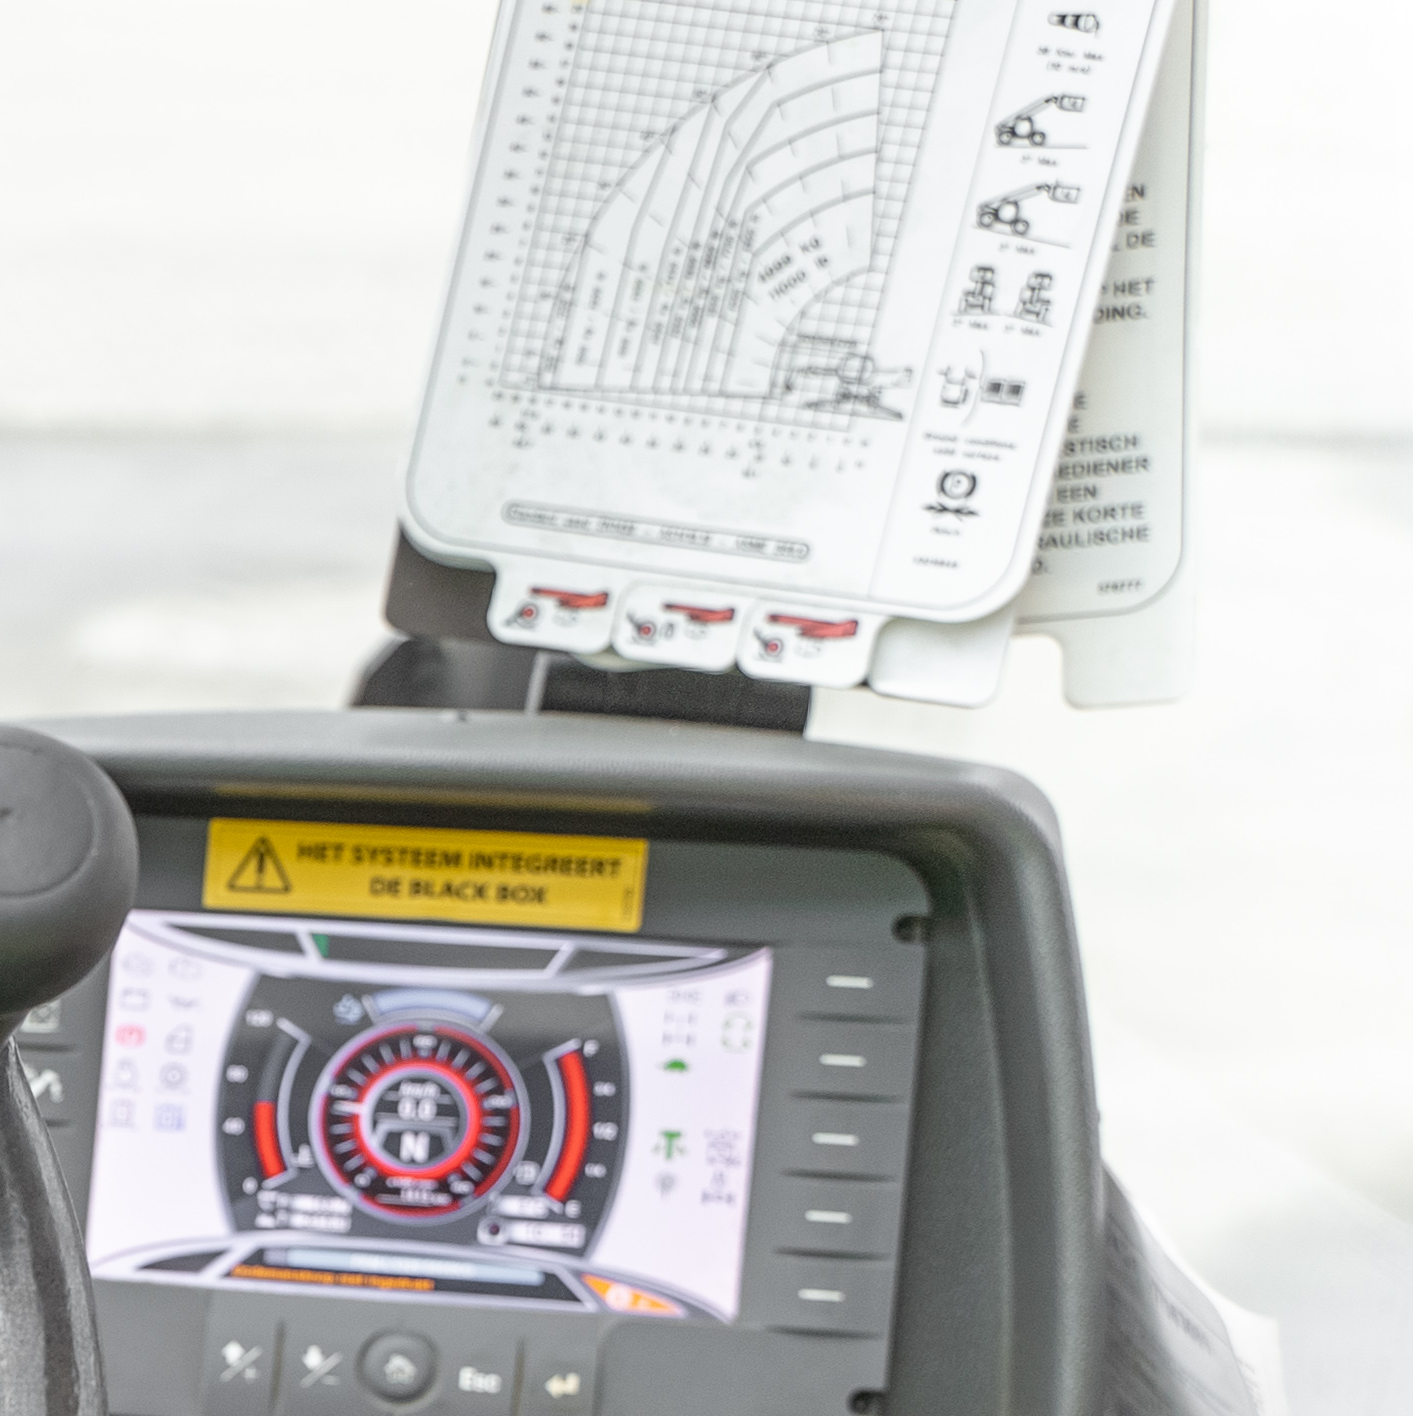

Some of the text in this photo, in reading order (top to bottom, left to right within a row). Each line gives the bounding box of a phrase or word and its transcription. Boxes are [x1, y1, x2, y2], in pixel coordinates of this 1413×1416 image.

[1072, 502, 1144, 523] KORTE
[297, 842, 622, 879] HET SYSTEEM INTEGREERT
[369, 876, 546, 904] DE BLACK BOX
[400, 1130, 430, 1163] N
